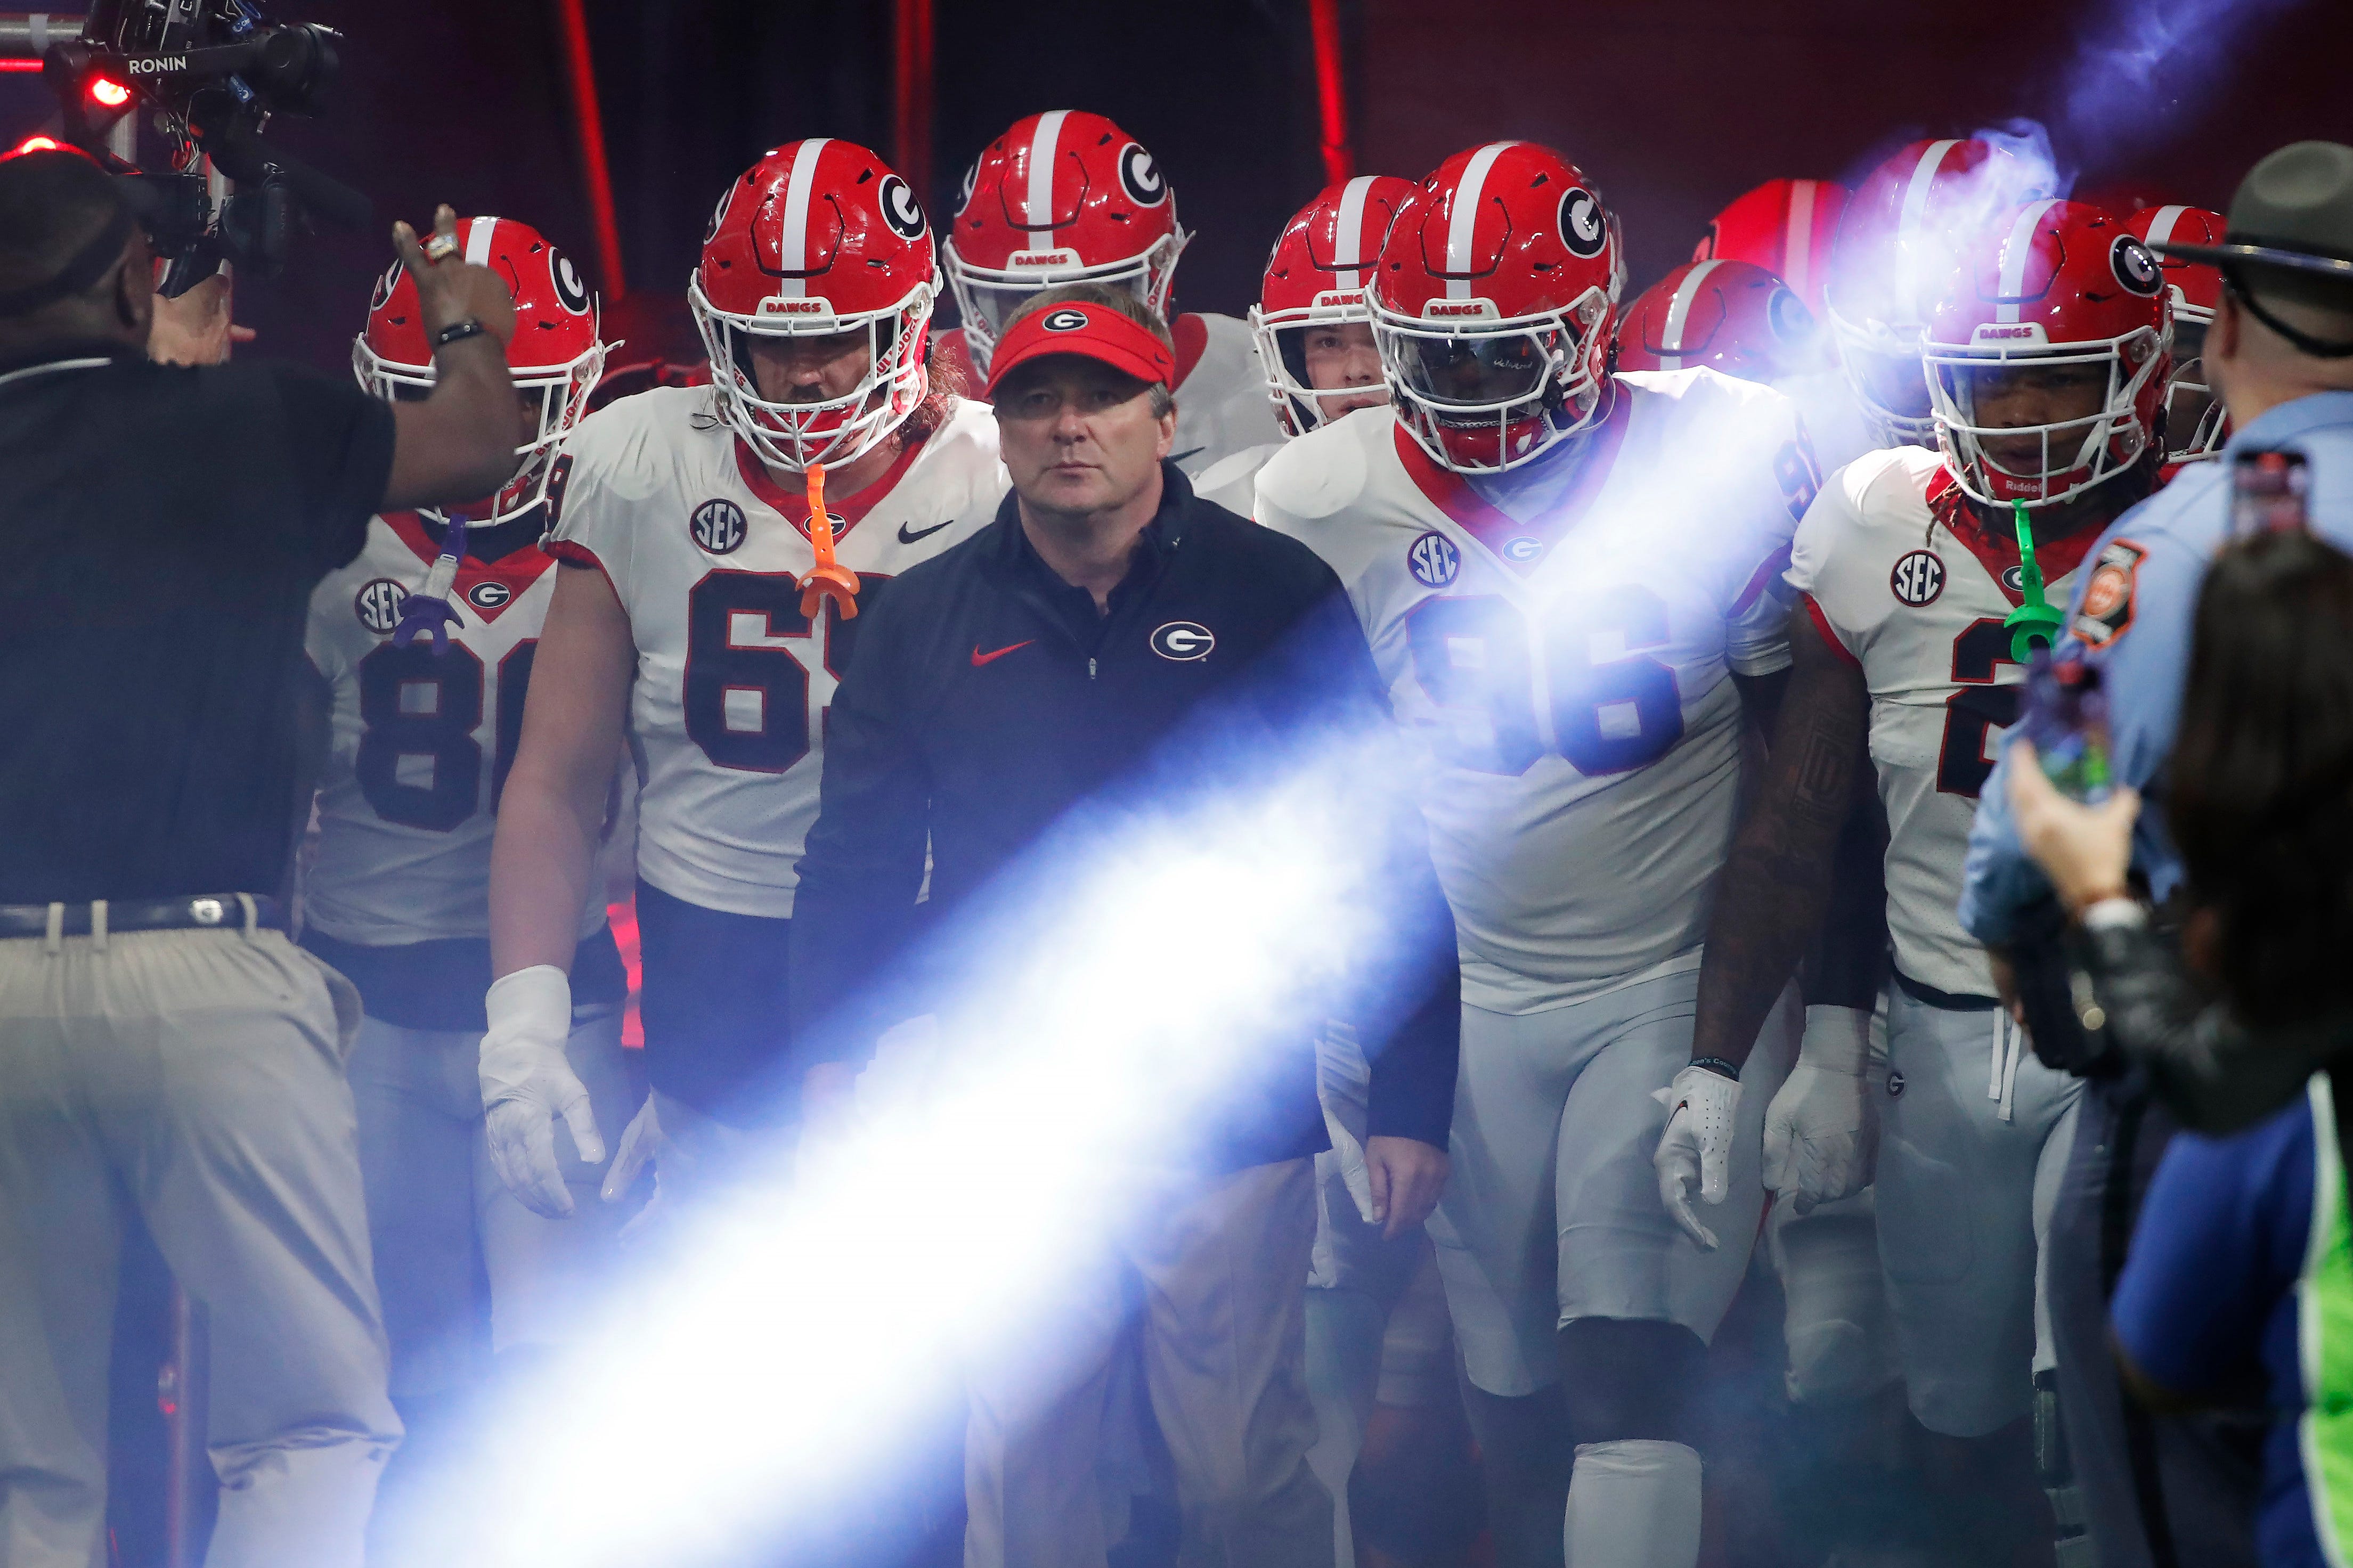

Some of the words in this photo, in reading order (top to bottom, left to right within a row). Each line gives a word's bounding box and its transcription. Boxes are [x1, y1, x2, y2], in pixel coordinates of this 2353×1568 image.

[129, 56, 186, 74] RONIN
[1015, 254, 1068, 265] DAWGS
[767, 302, 821, 313] DAWGS
[1321, 294, 1362, 306] DAWG
[1430, 304, 1483, 316] DAWGS
[1980, 326, 2032, 339] DAWGS
[2005, 480, 2047, 492] Riddel
[697, 504, 741, 549] SEC
[1412, 536, 1455, 583] SEC
[1896, 554, 1940, 602] SEC
[361, 583, 406, 628] SEC
[682, 568, 874, 774] 6
[1405, 583, 1684, 777] 96
